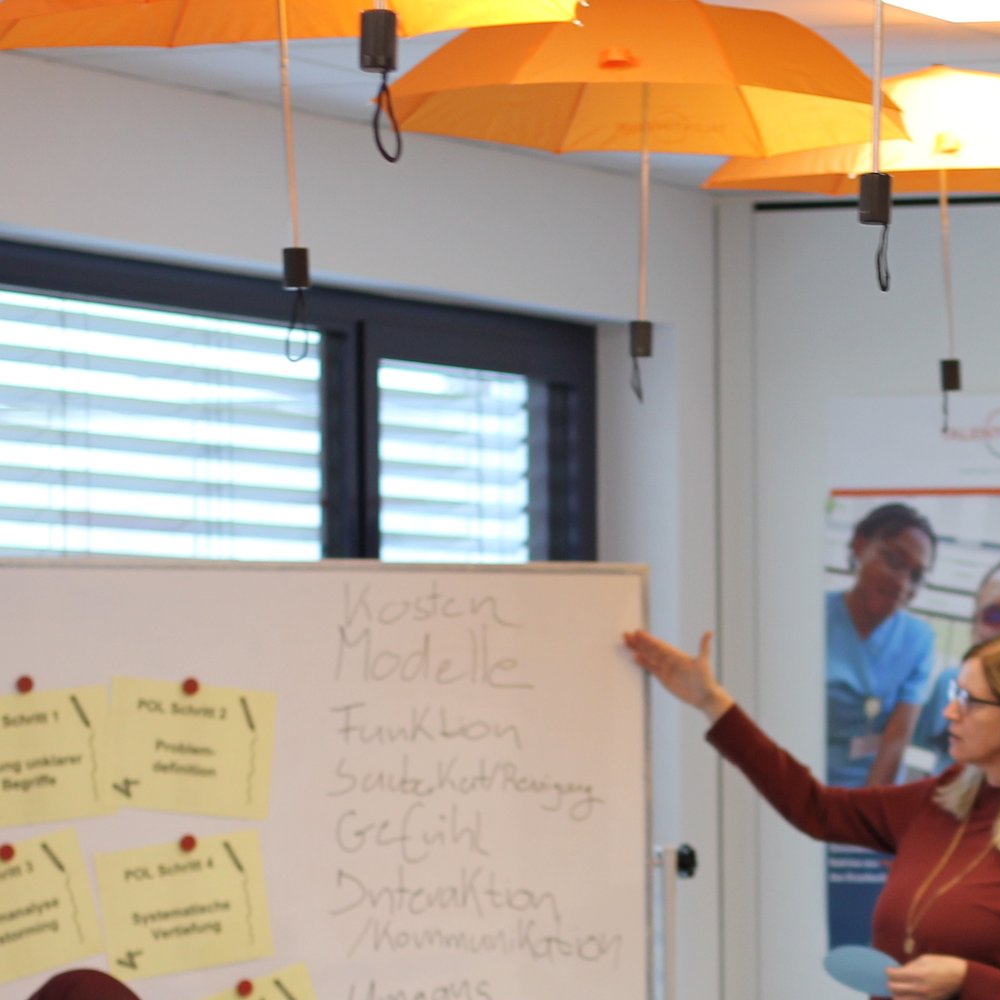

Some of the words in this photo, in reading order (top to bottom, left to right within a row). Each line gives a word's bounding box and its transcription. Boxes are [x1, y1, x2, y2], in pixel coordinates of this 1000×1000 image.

[343, 578, 525, 629] Kosten
[333, 623, 536, 691] Modelle
[2, 710, 48, 728] Schritt
[138, 698, 165, 714] POL
[171, 702, 216, 718] Schritt
[219, 707, 228, 720] 2
[25, 754, 83, 770] unklarer
[152, 760, 217, 777] definition
[2, 773, 57, 793] Begriffe
[335, 801, 491, 864] Gefühl
[26, 860, 34, 874] 3
[124, 868, 153, 882] POL
[158, 860, 203, 876] Schritt
[207, 857, 215, 869] 4
[132, 900, 231, 926] Systematische
[152, 920, 222, 940] Vertiefung
